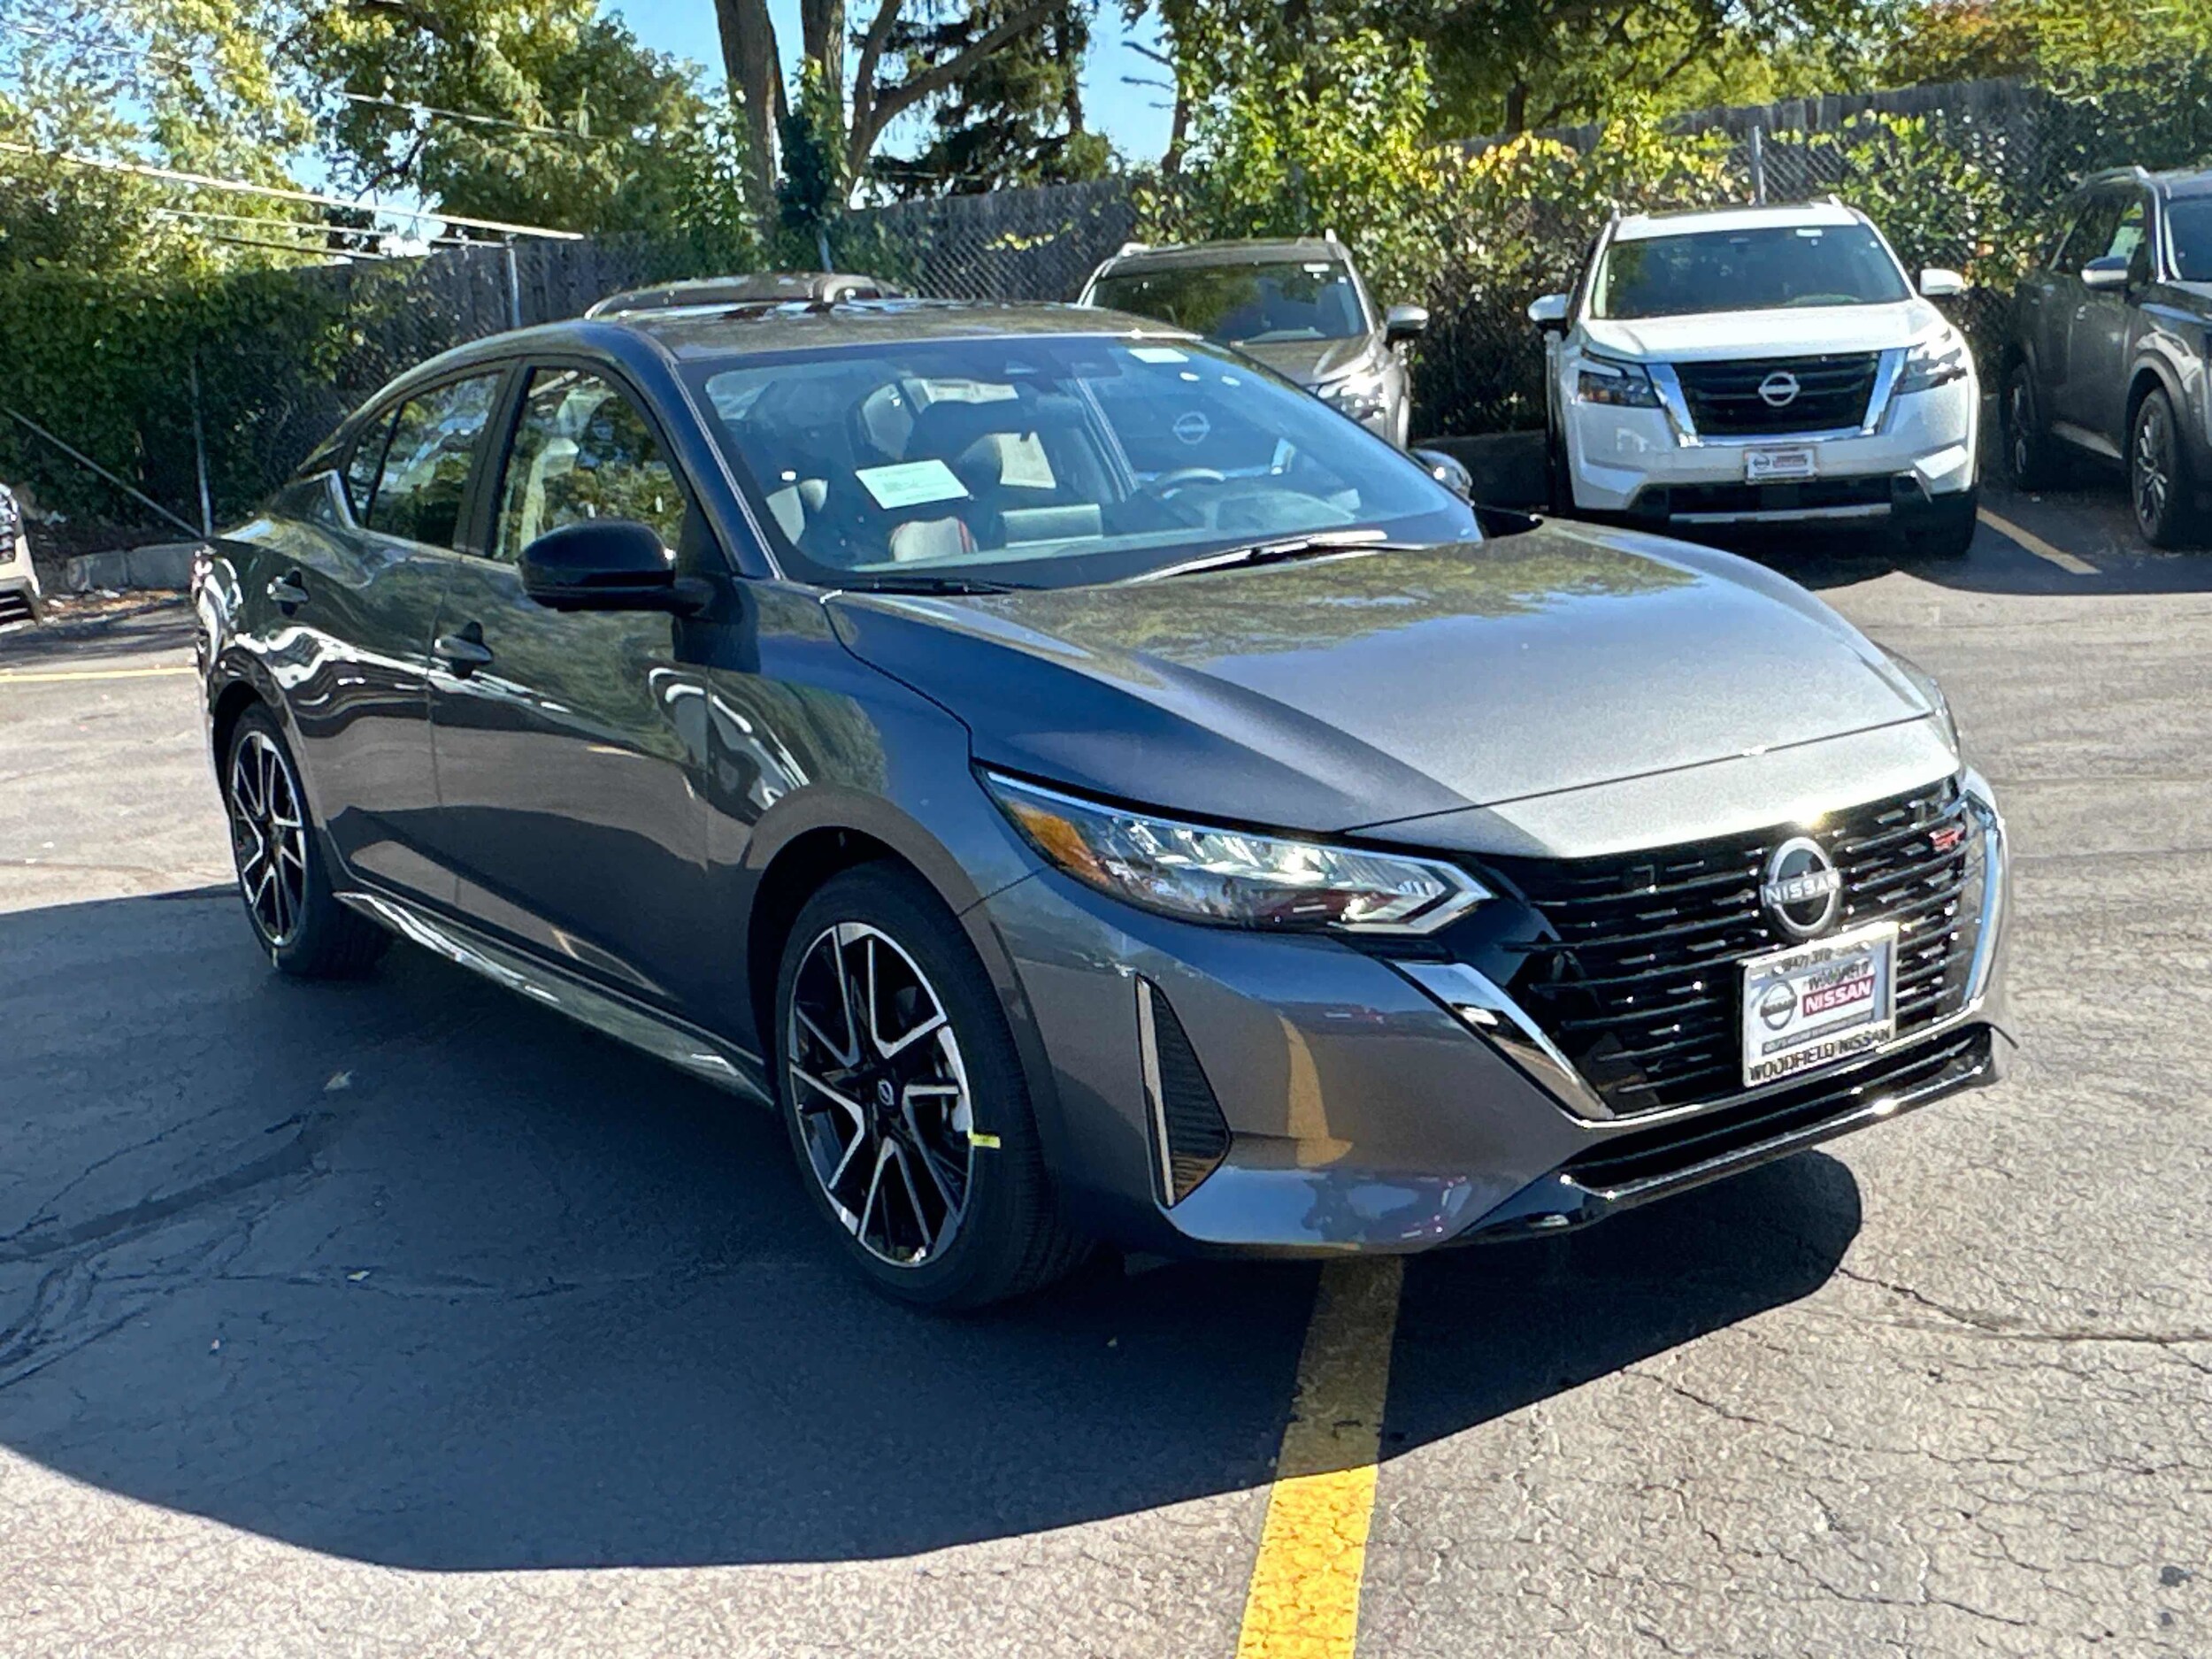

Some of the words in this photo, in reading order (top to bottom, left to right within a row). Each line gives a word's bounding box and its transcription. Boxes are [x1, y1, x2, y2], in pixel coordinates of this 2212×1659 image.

[1764, 872, 1839, 904] NISSAN
[1805, 978, 1871, 1015] NISSAN
[1748, 1042, 1836, 1081] WOODFIELD
[1838, 1026, 1891, 1055] NISSAN
